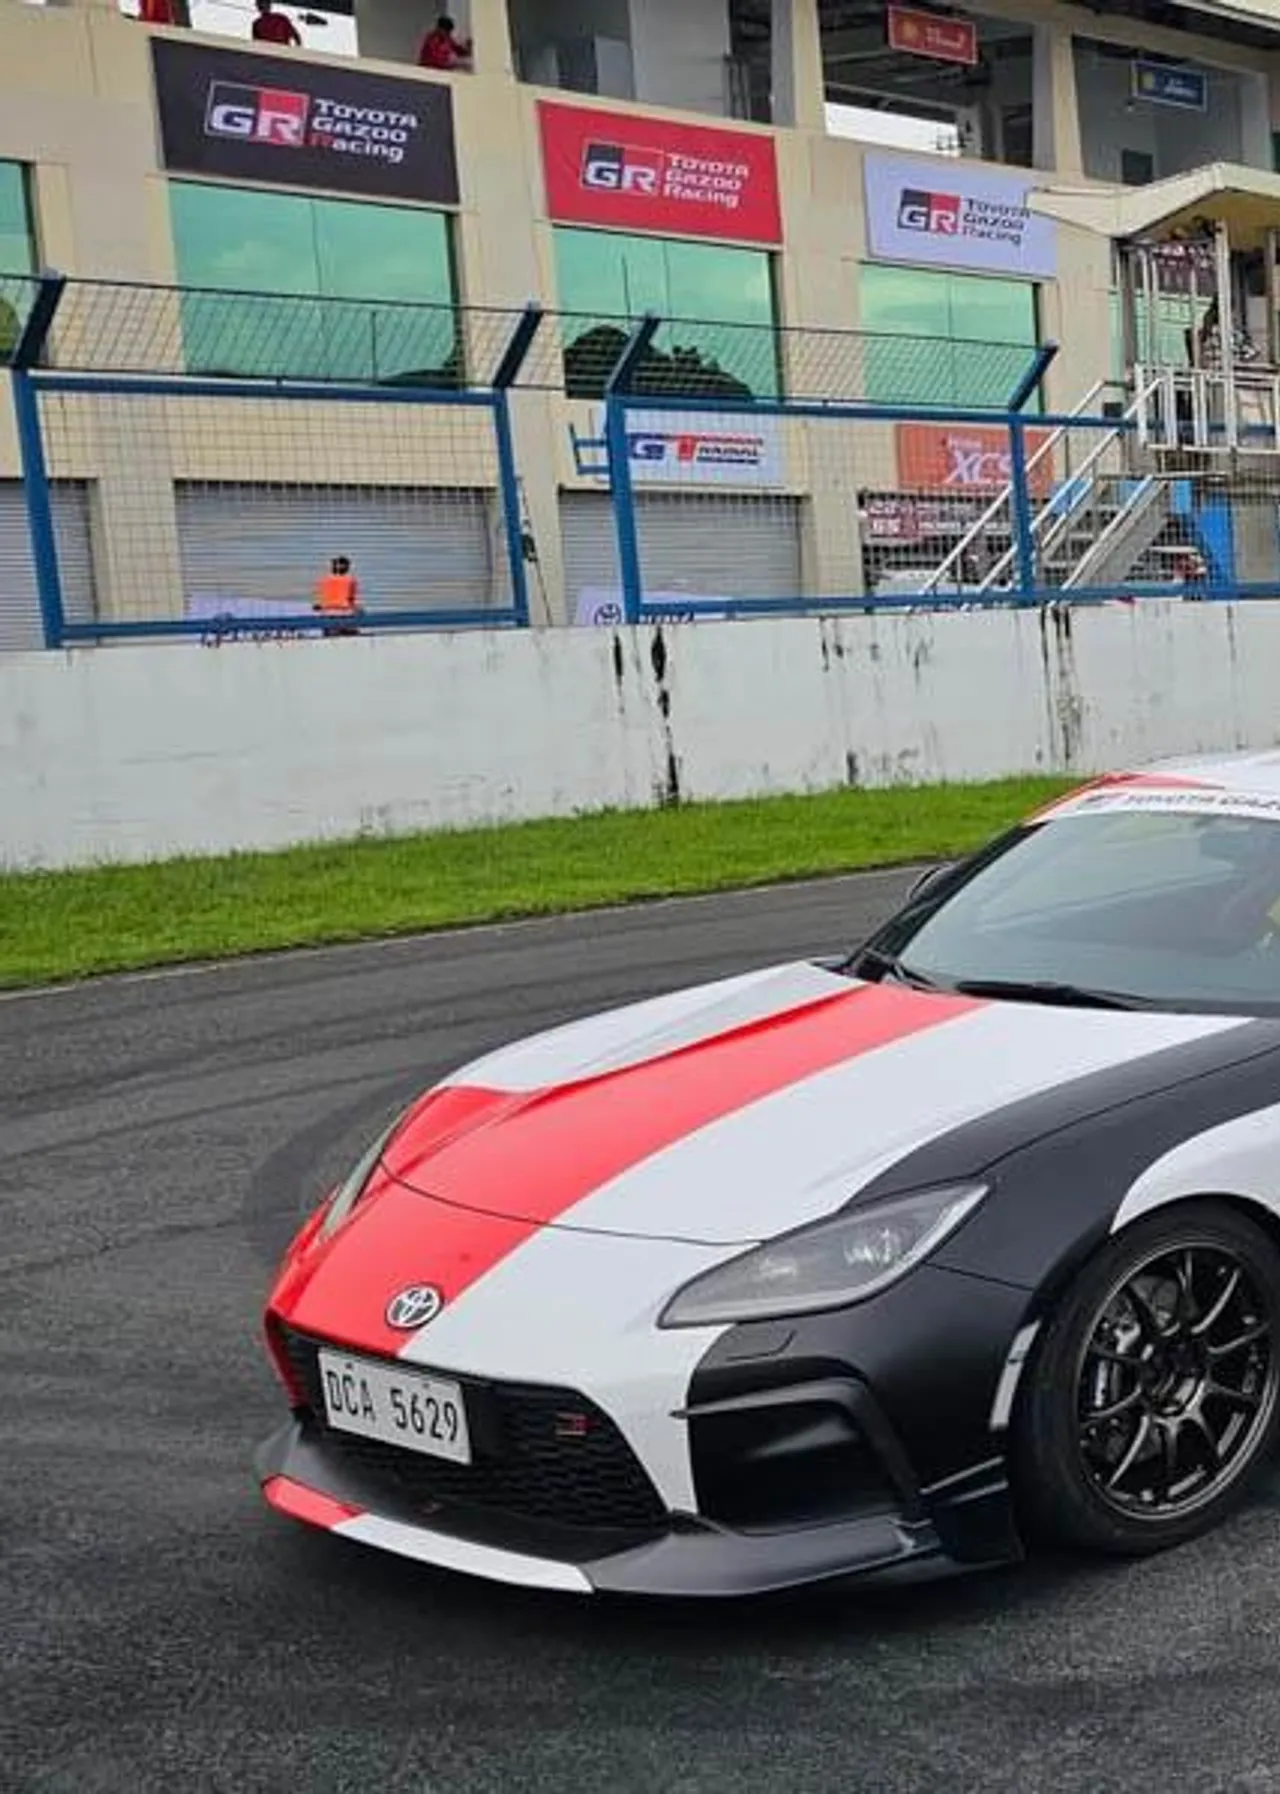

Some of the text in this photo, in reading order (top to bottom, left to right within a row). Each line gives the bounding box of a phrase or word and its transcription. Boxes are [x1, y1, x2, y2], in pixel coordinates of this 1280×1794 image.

[209, 103, 304, 146] GR
[312, 98, 418, 128] TOYOTA
[311, 116, 409, 143] GAZOO
[309, 133, 405, 164] Racing
[585, 160, 657, 193] GR
[666, 153, 749, 177] TOYOTA
[665, 168, 742, 191] GAZOO
[663, 183, 740, 208] Racing
[964, 198, 1031, 219] TOYOTA
[899, 204, 958, 234] GR
[963, 212, 1025, 231] GAZOO
[962, 225, 1022, 246] Racing
[326, 1370, 459, 1442] DCA 5629
